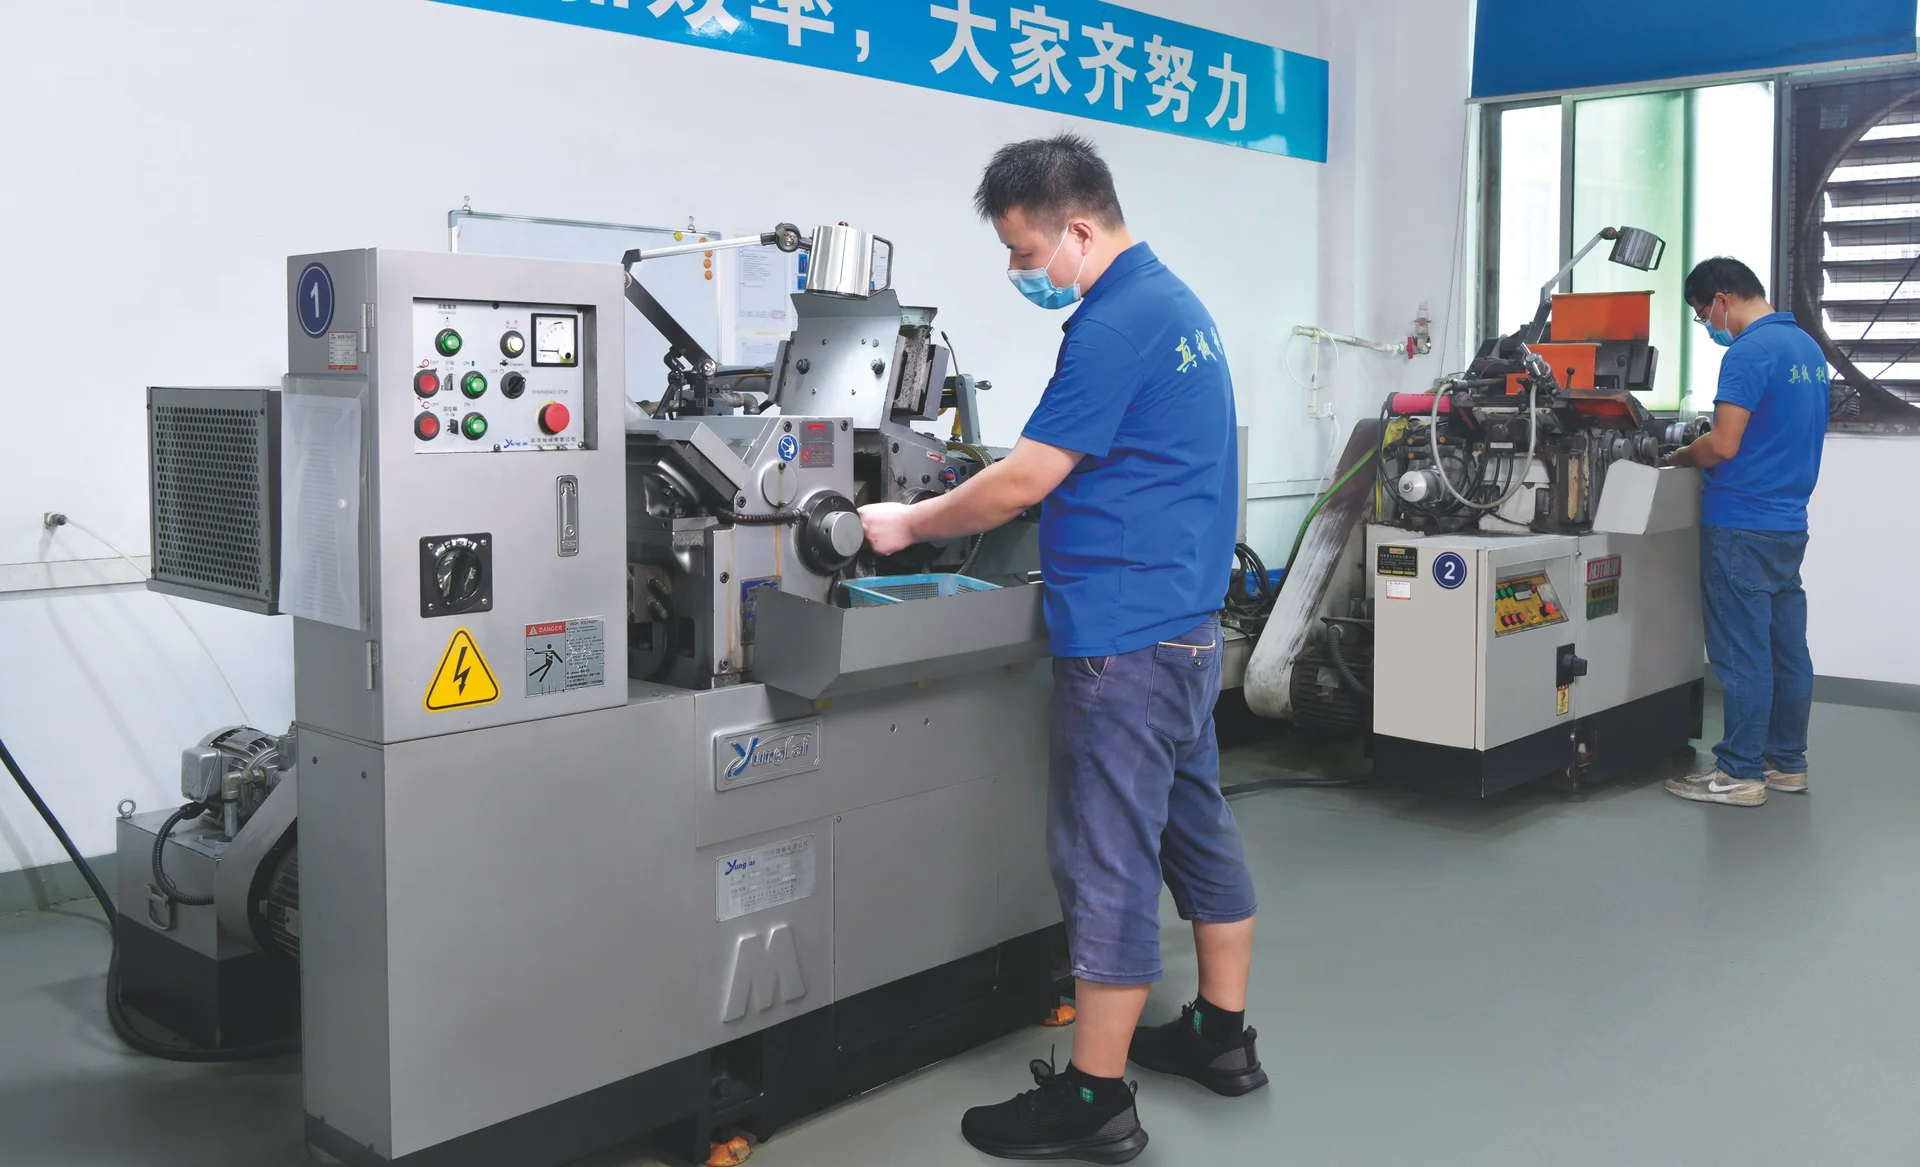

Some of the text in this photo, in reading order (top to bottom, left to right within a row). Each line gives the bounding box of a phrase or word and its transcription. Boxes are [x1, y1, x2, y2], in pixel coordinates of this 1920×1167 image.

[310, 281, 320, 319] 1
[1443, 560, 1456, 580] 2
[538, 624, 563, 633] DANGER
